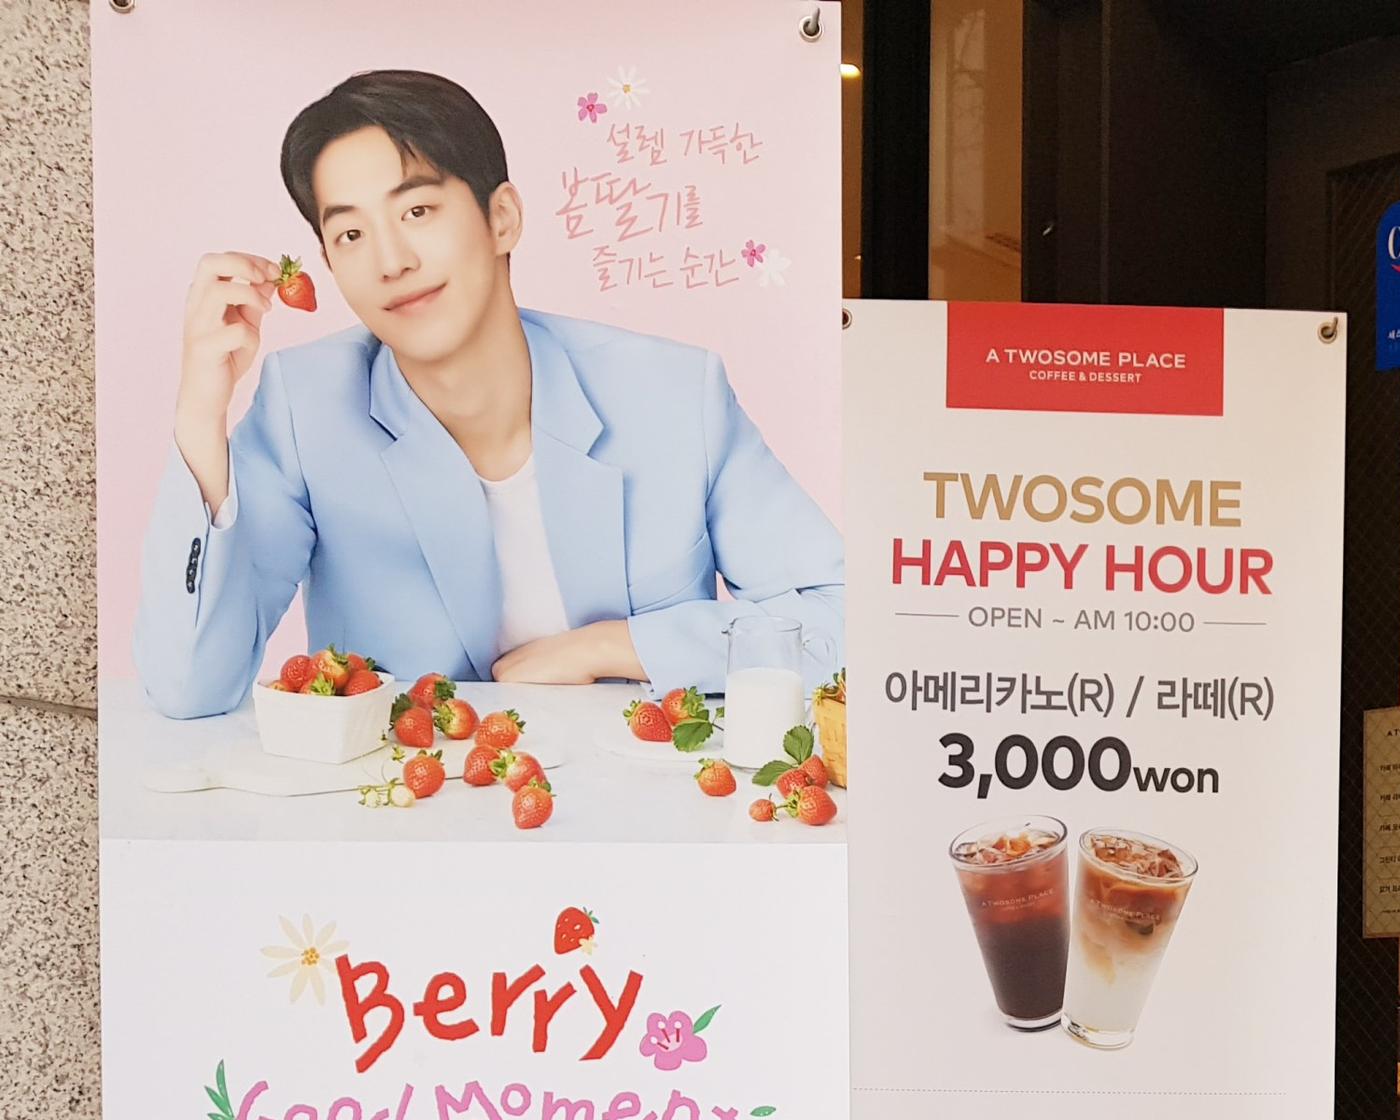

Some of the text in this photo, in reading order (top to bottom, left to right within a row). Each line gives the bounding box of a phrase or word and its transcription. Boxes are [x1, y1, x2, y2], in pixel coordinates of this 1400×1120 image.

[606, 121, 764, 167] 설렘 가득한
[555, 166, 704, 242] 봄딸기를
[592, 244, 740, 292] 즐기는 순간
[985, 348, 1186, 369] A TWOSOME PLACE
[1028, 370, 1142, 383] COFFEE & DESSERT
[922, 471, 1242, 528] TWOSOME
[892, 537, 1274, 595] HAPPY HOUR
[968, 606, 1043, 629] OPEN
[1073, 609, 1115, 631] AM
[1124, 610, 1195, 633] 10:00
[885, 670, 1275, 721] 아메리카노(R) / 라떼(R)
[334, 953, 644, 1074] Berry
